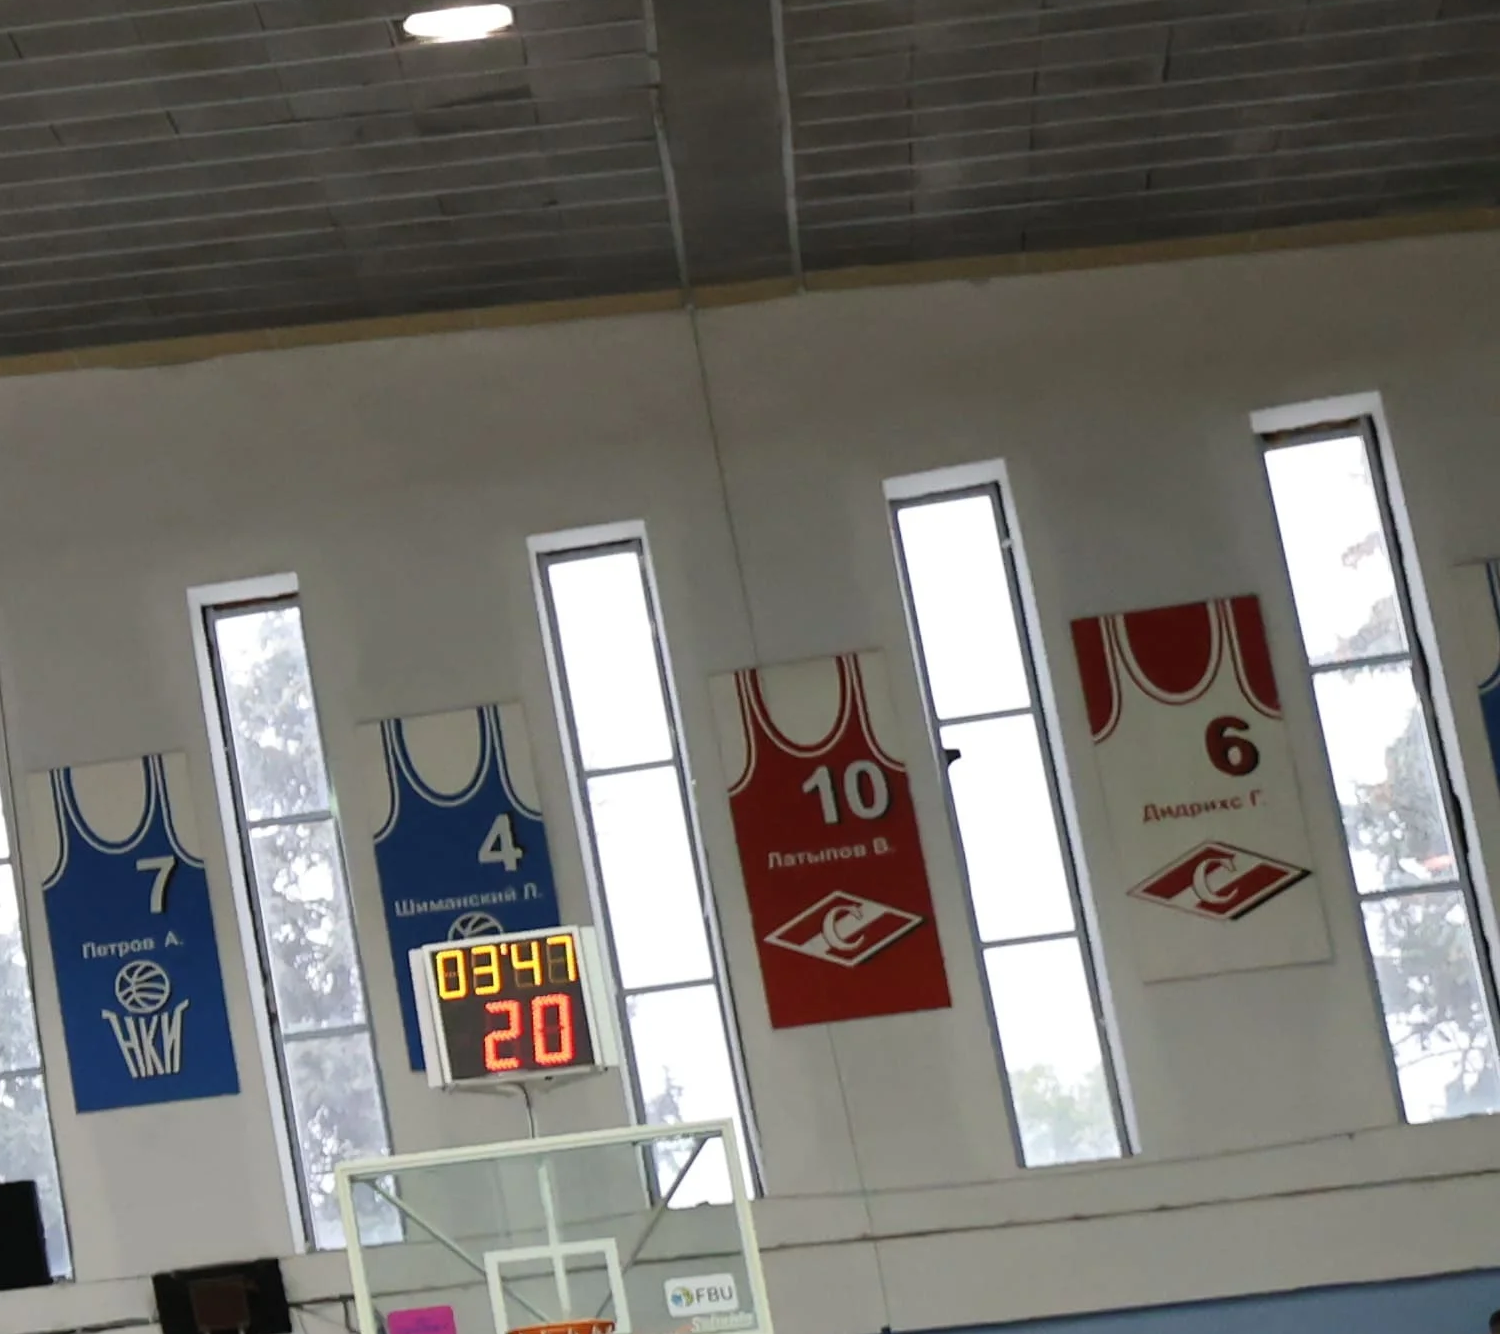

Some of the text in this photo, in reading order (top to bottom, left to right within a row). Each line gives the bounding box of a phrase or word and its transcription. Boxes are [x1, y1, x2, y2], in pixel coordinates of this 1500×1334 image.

[1205, 716, 1259, 777] 6
[802, 761, 891, 825] 10
[478, 814, 522, 871] 4
[136, 857, 176, 914] 7
[484, 993, 575, 1071] 20
[695, 1286, 734, 1304] FBU
